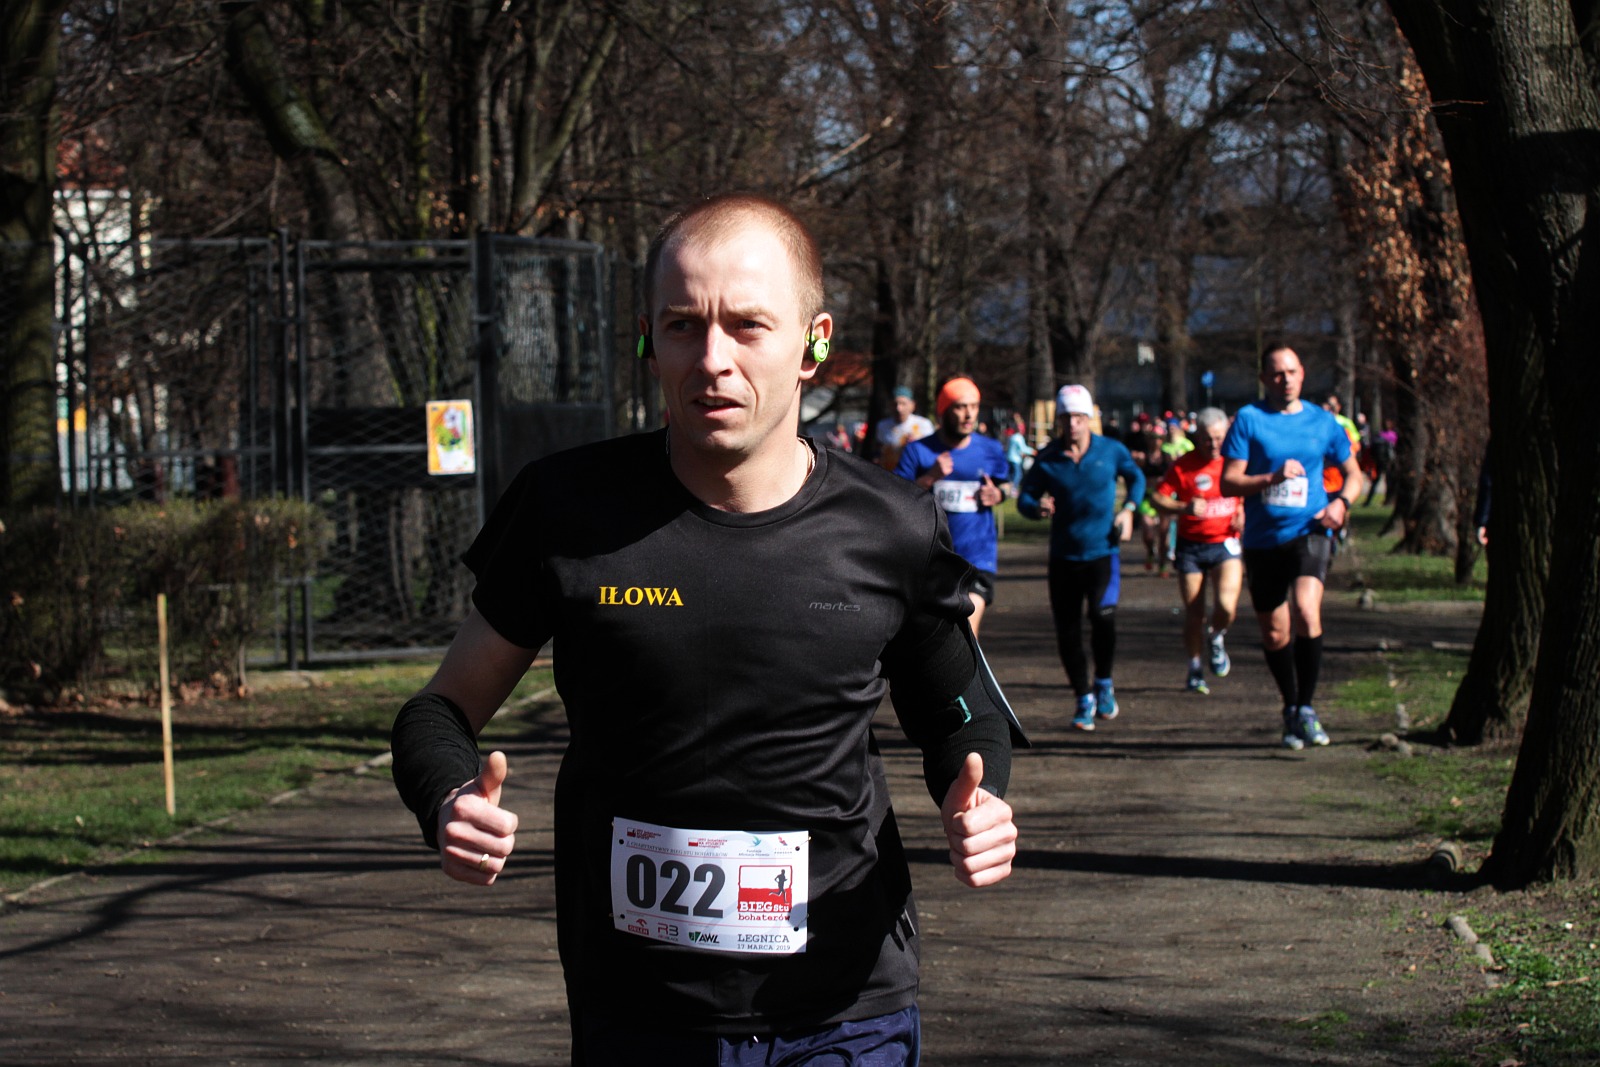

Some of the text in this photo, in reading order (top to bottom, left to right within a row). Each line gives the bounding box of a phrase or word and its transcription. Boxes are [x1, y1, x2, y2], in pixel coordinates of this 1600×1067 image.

[598, 586, 684, 606] IŁOWA
[809, 601, 861, 612] martes
[626, 854, 724, 918] 022
[739, 901, 790, 912] BIEG stu
[738, 913, 790, 921] bohaterów
[699, 932, 720, 944] AWL
[737, 933, 790, 943] LEGNICA
